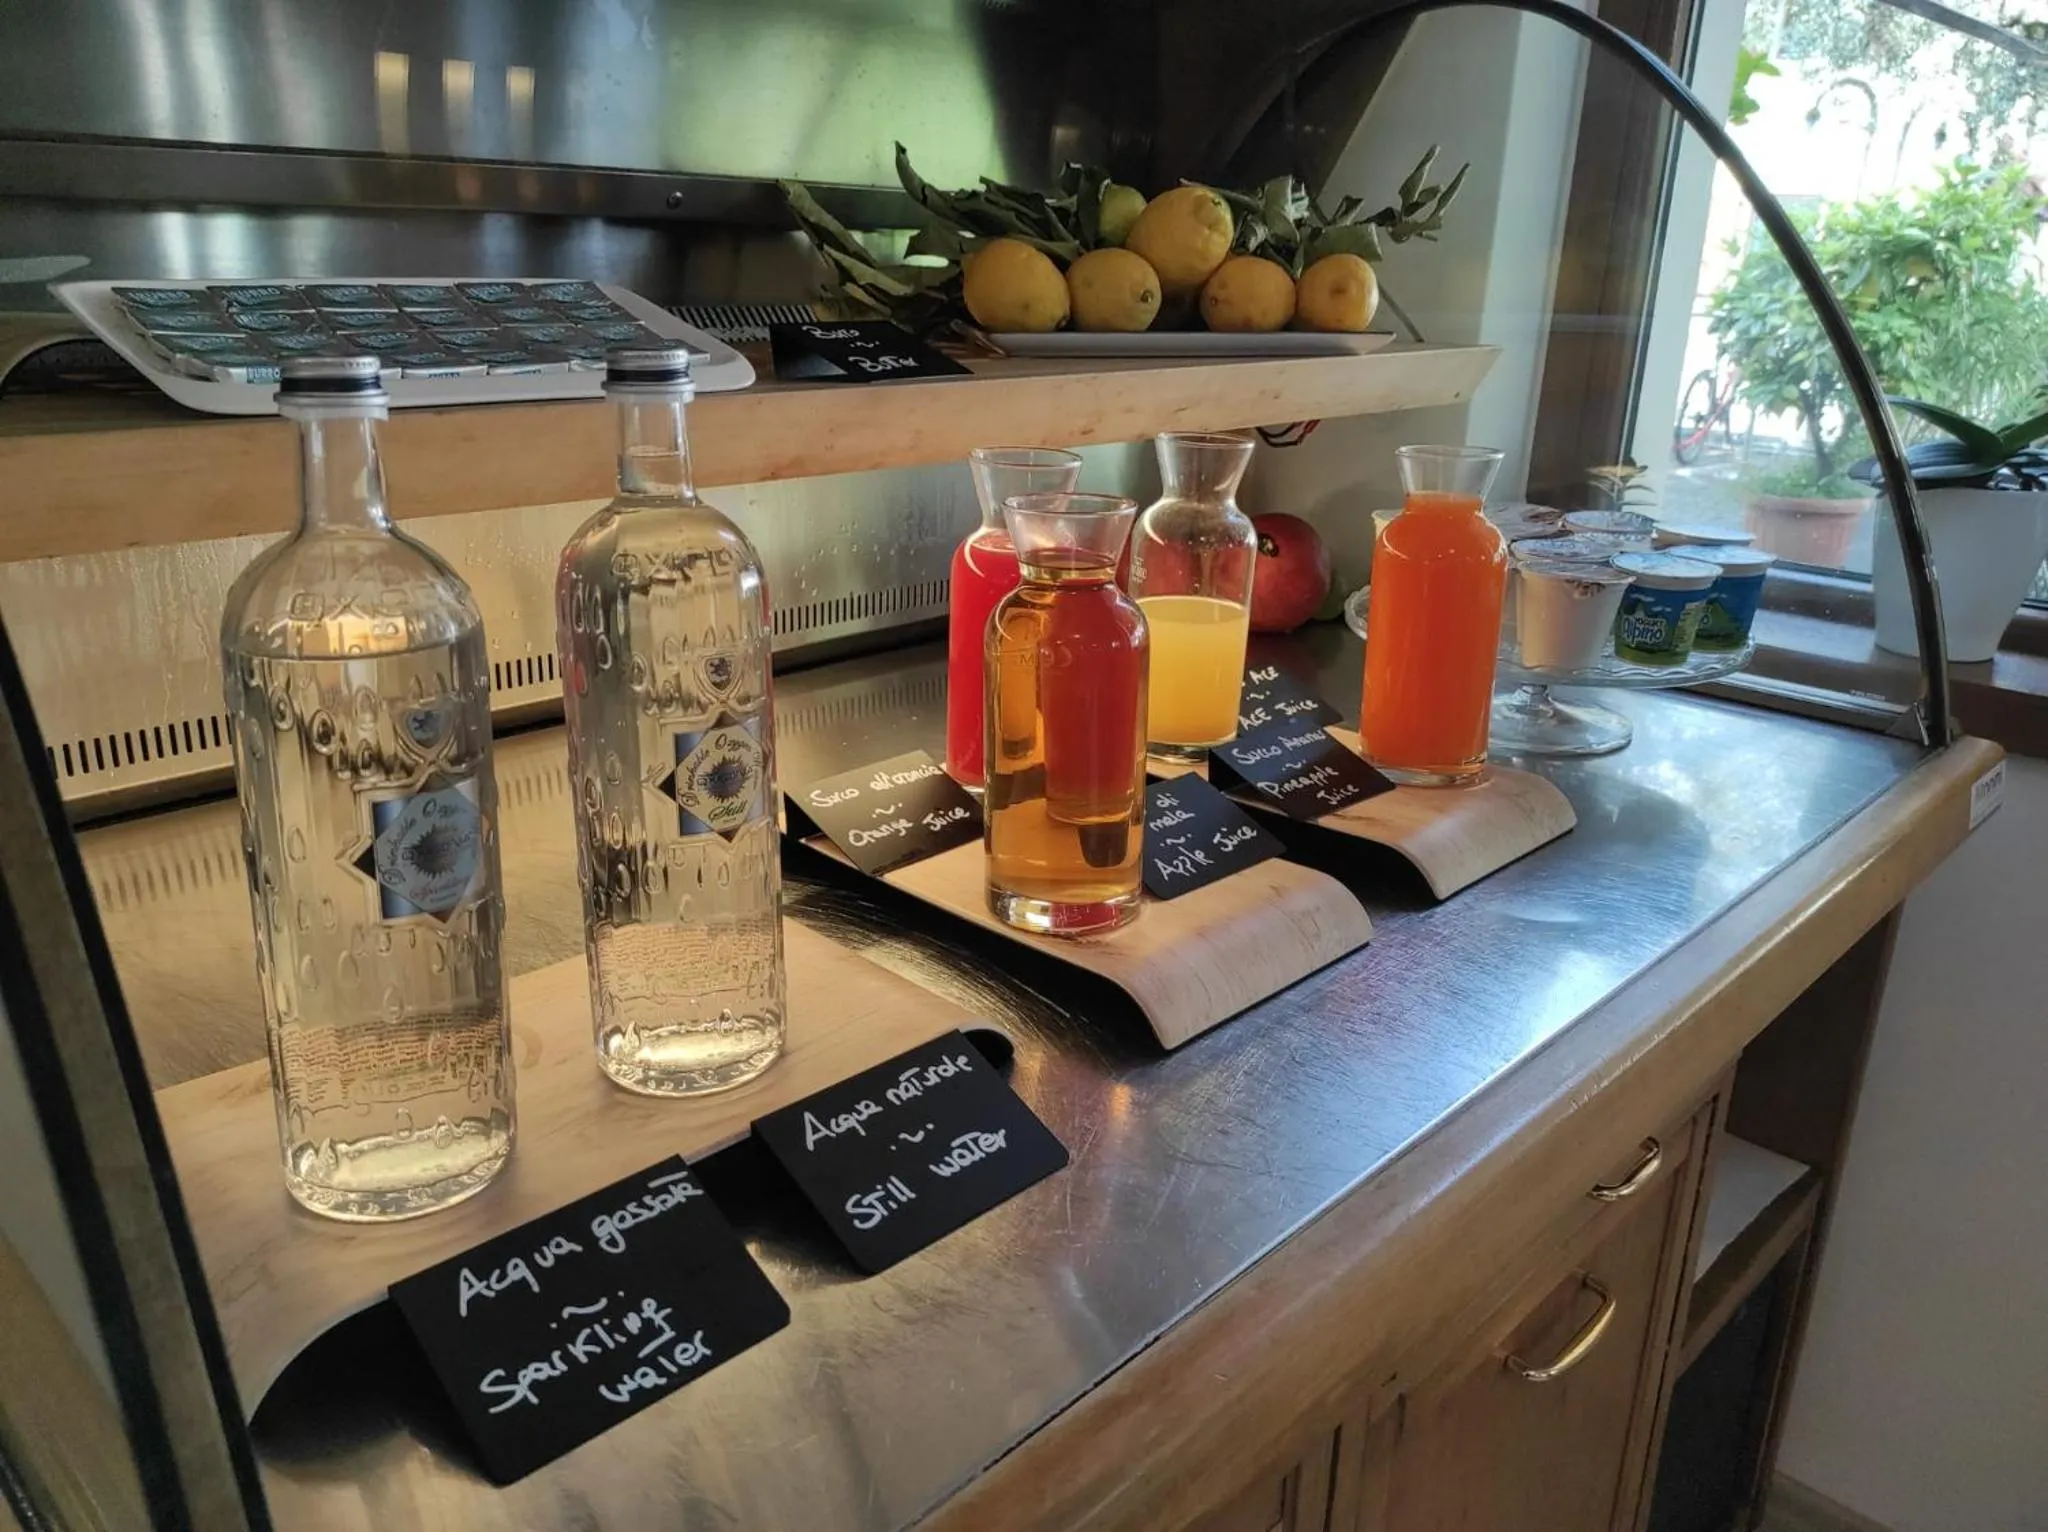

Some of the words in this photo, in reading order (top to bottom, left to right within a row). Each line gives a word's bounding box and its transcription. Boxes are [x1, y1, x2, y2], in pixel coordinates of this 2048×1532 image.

[1238, 706, 1273, 731] ACE
[1273, 698, 1320, 717] Juice
[1256, 764, 1340, 800] Pineapple
[1316, 782, 1361, 806] Juice
[848, 817, 914, 847] Orange
[922, 805, 971, 831] Juice
[1149, 809, 1197, 832] mela
[1153, 845, 1215, 883] Apple
[1212, 824, 1258, 853] Juice
[803, 1099, 884, 1152] Acqua
[885, 1053, 974, 1106] naturale
[845, 1174, 917, 1230] Still
[928, 1128, 1007, 1178] water
[458, 1236, 584, 1318] Acqua
[590, 1170, 704, 1254] gassata
[599, 1330, 712, 1403] water
